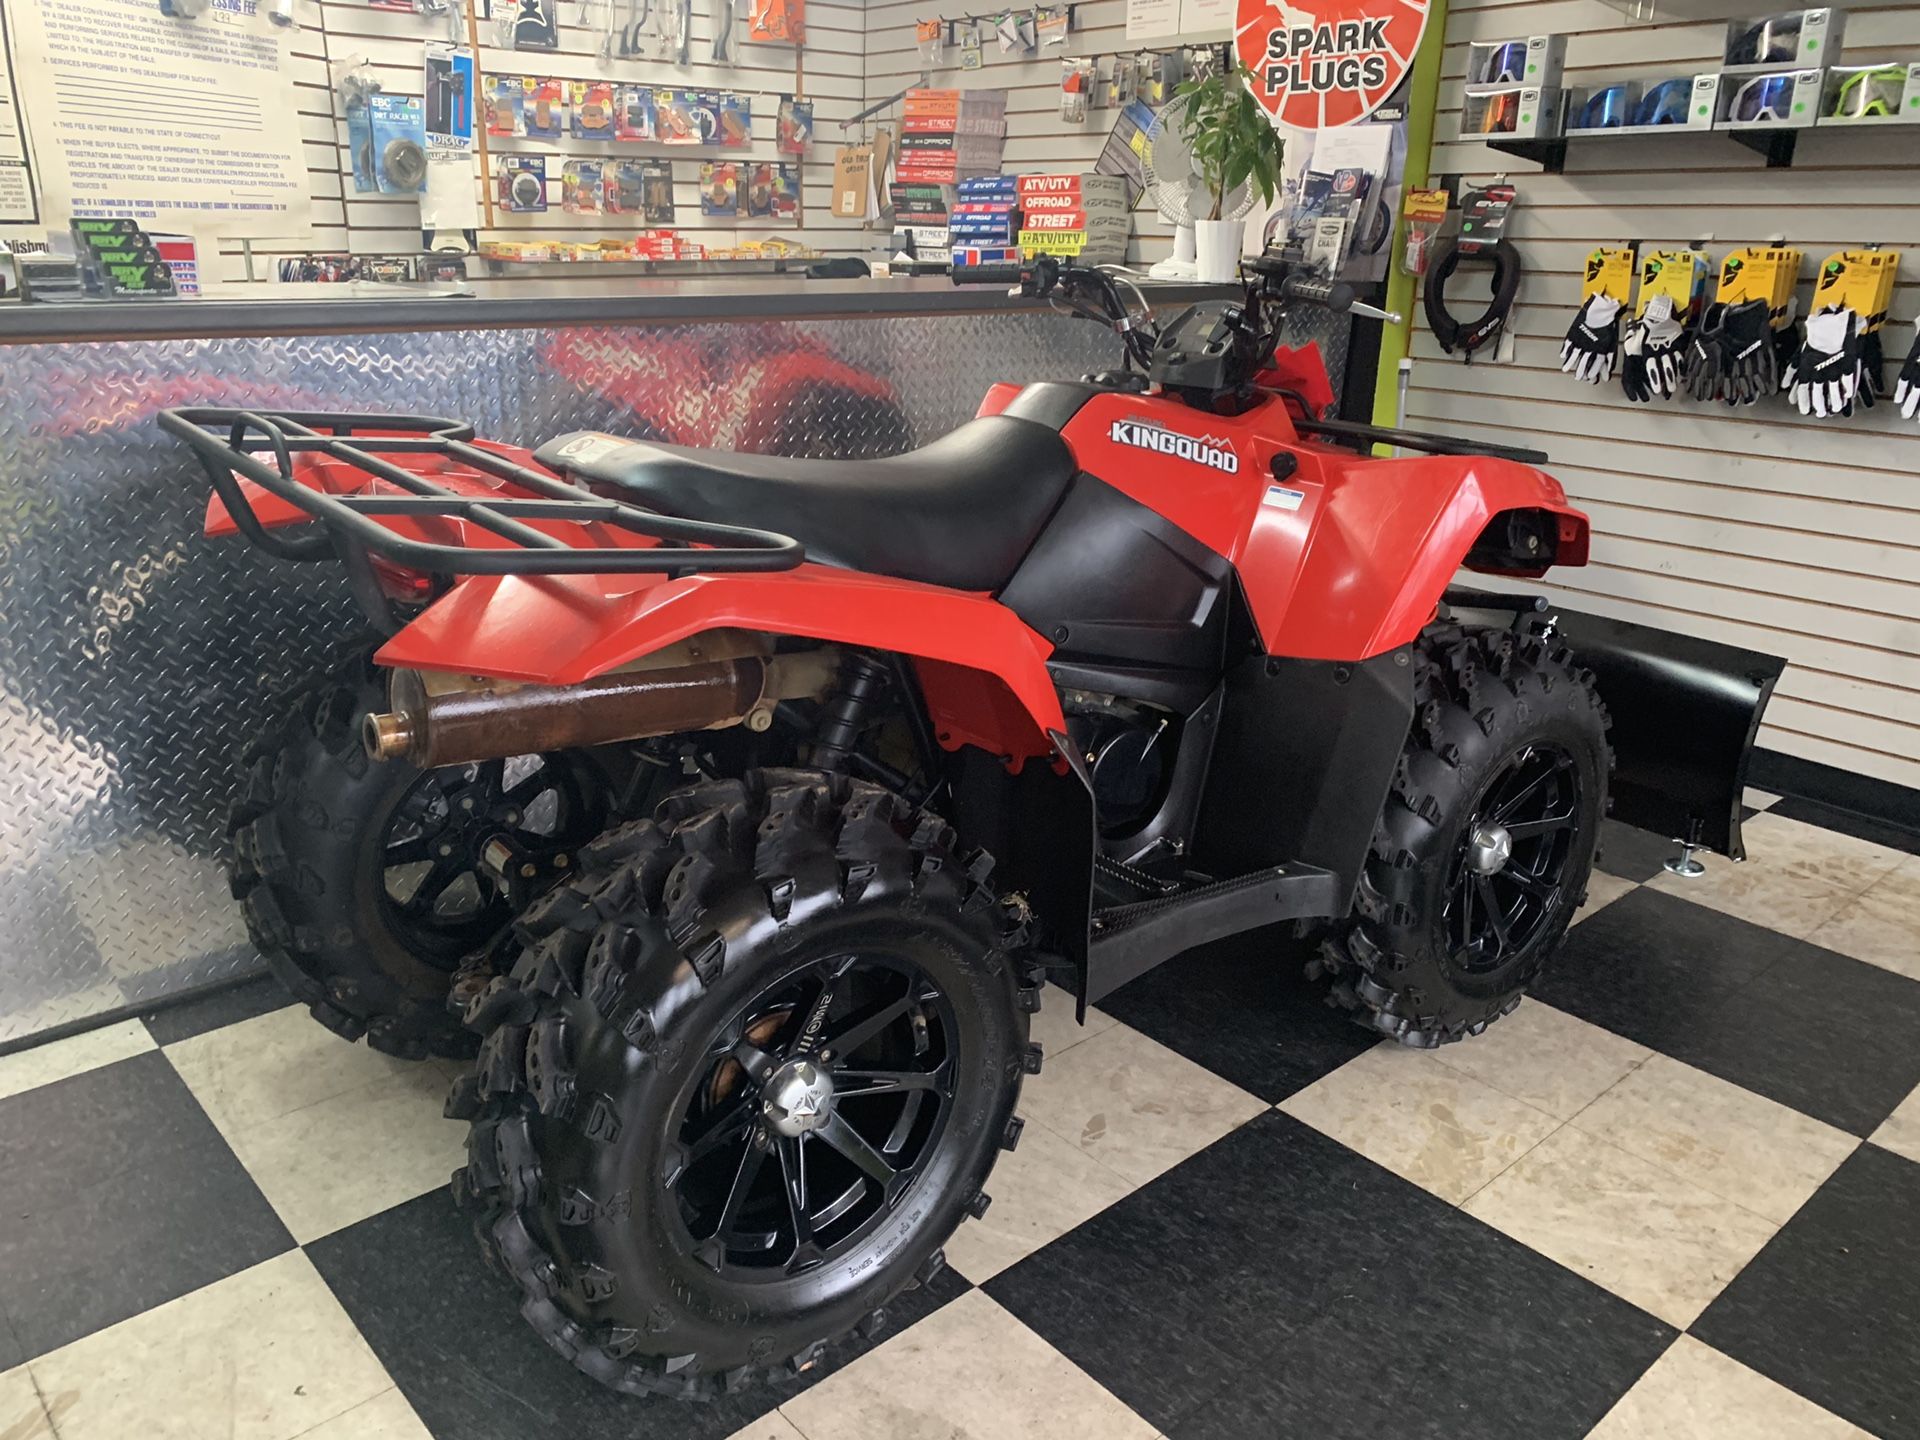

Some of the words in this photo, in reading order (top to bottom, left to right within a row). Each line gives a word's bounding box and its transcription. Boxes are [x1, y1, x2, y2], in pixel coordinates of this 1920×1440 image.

[244, 0, 256, 14] FEE
[1266, 18, 1389, 60] SPARK
[1266, 56, 1386, 94] PLUGS
[372, 97, 391, 107] EBC
[928, 120, 956, 128] STREET
[1024, 177, 1072, 192] ATV/UTV
[1026, 196, 1072, 208] OFFROAD
[1028, 214, 1076, 228] STREET
[1032, 232, 1080, 245] ATV/UTV
[1578, 324, 1599, 342] THOR
[1736, 340, 1762, 360] THOR
[1814, 351, 1846, 372] THOR
[1111, 421, 1239, 475] KINGQUAD
[850, 1257, 874, 1278] SERVICE
